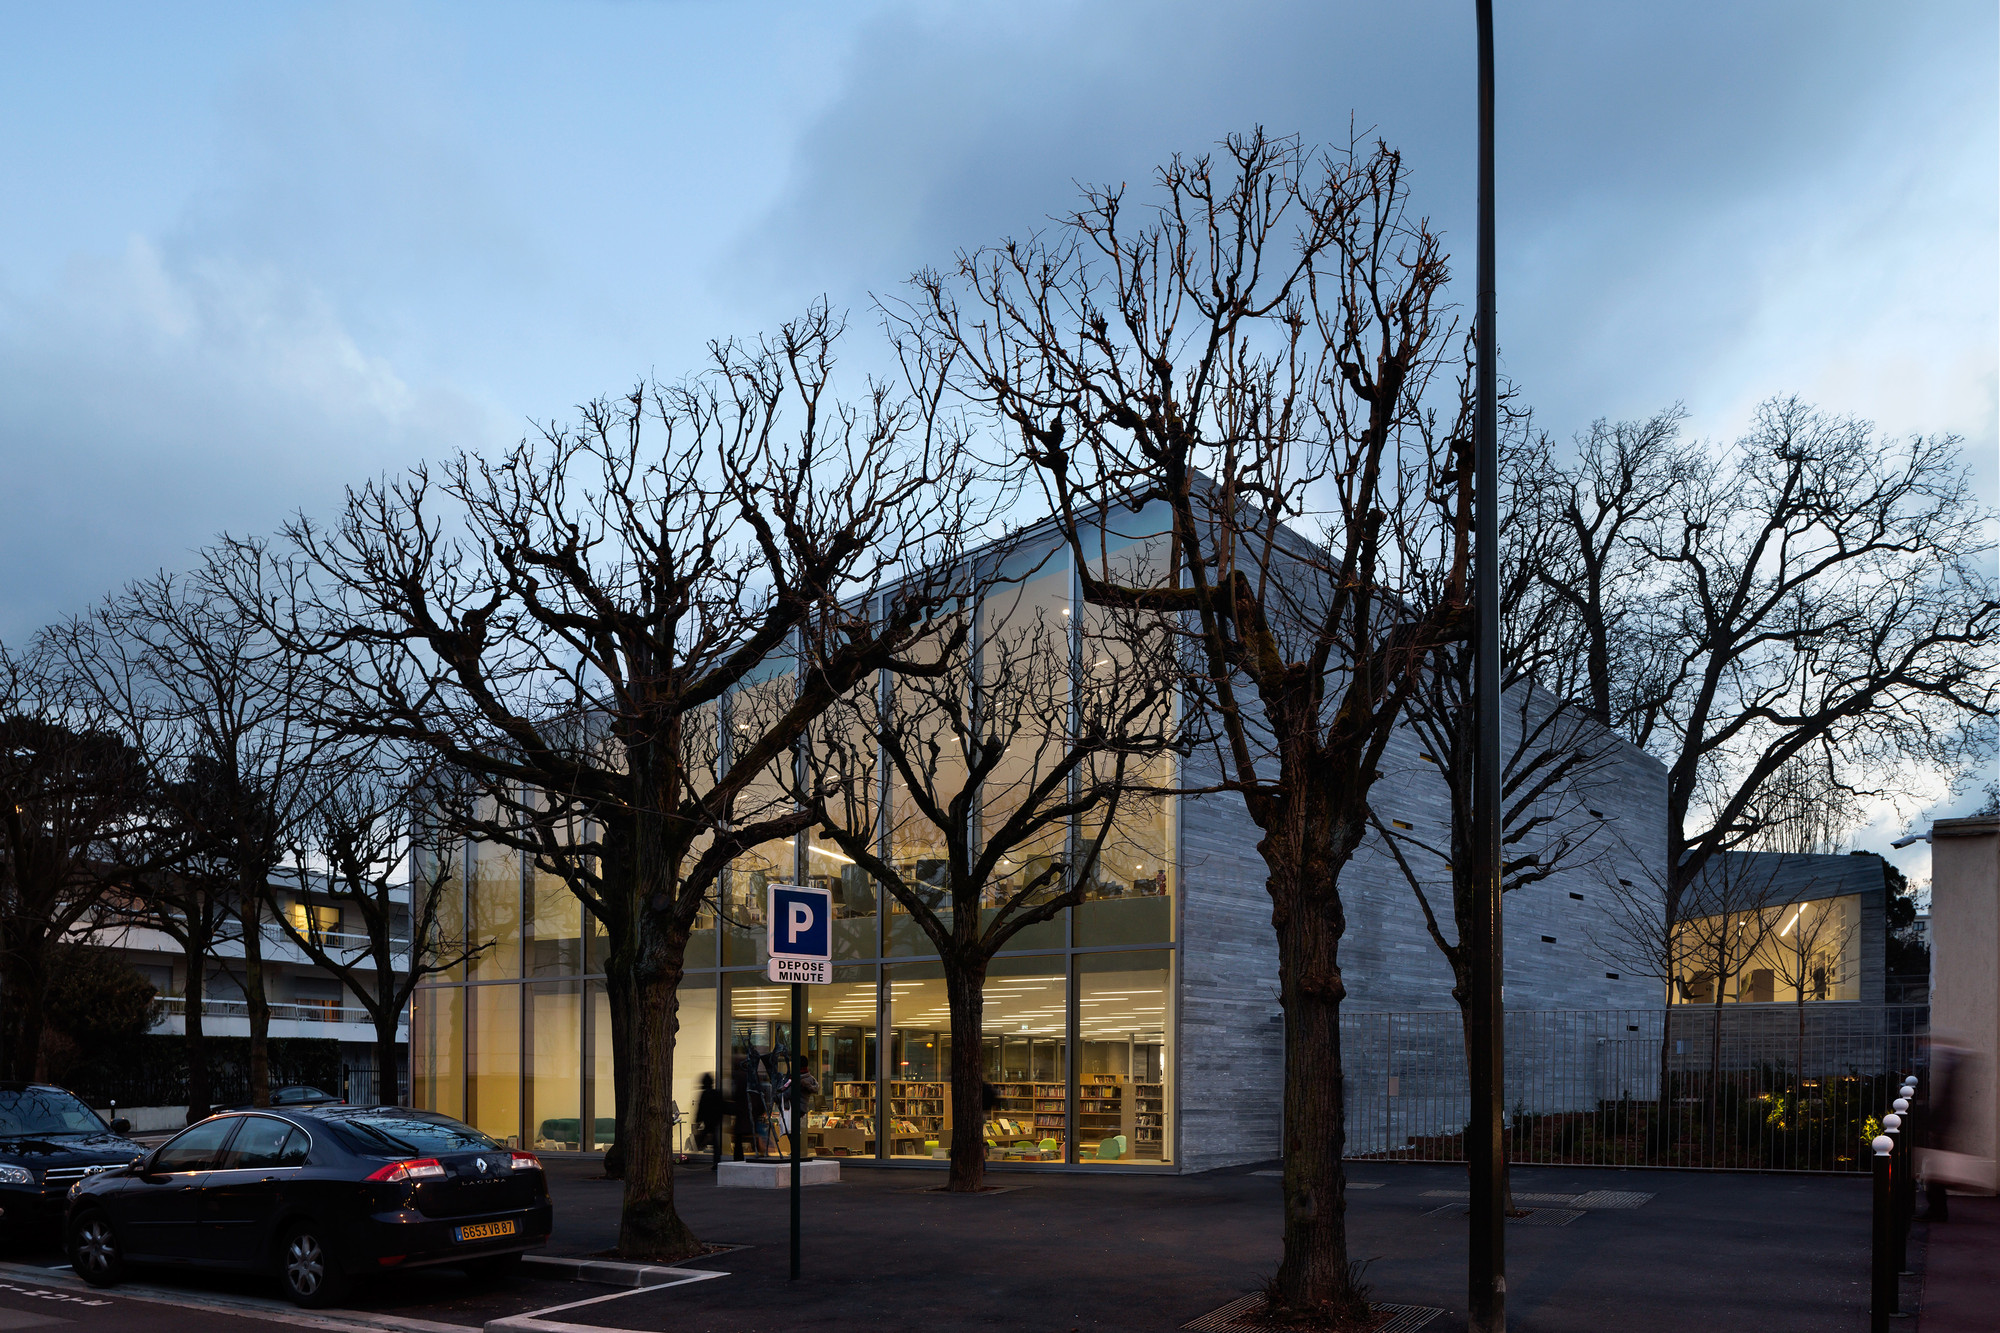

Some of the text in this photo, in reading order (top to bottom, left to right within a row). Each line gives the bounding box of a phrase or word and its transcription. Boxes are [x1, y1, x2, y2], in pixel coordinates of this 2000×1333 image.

[788, 901, 814, 944] P
[778, 960, 824, 971] DEPOSE
[779, 971, 824, 982] MINUTE
[461, 1178, 506, 1186] LAGUNA
[463, 1225, 488, 1239] 6653
[488, 1224, 501, 1235] VB
[501, 1222, 512, 1233] 87
